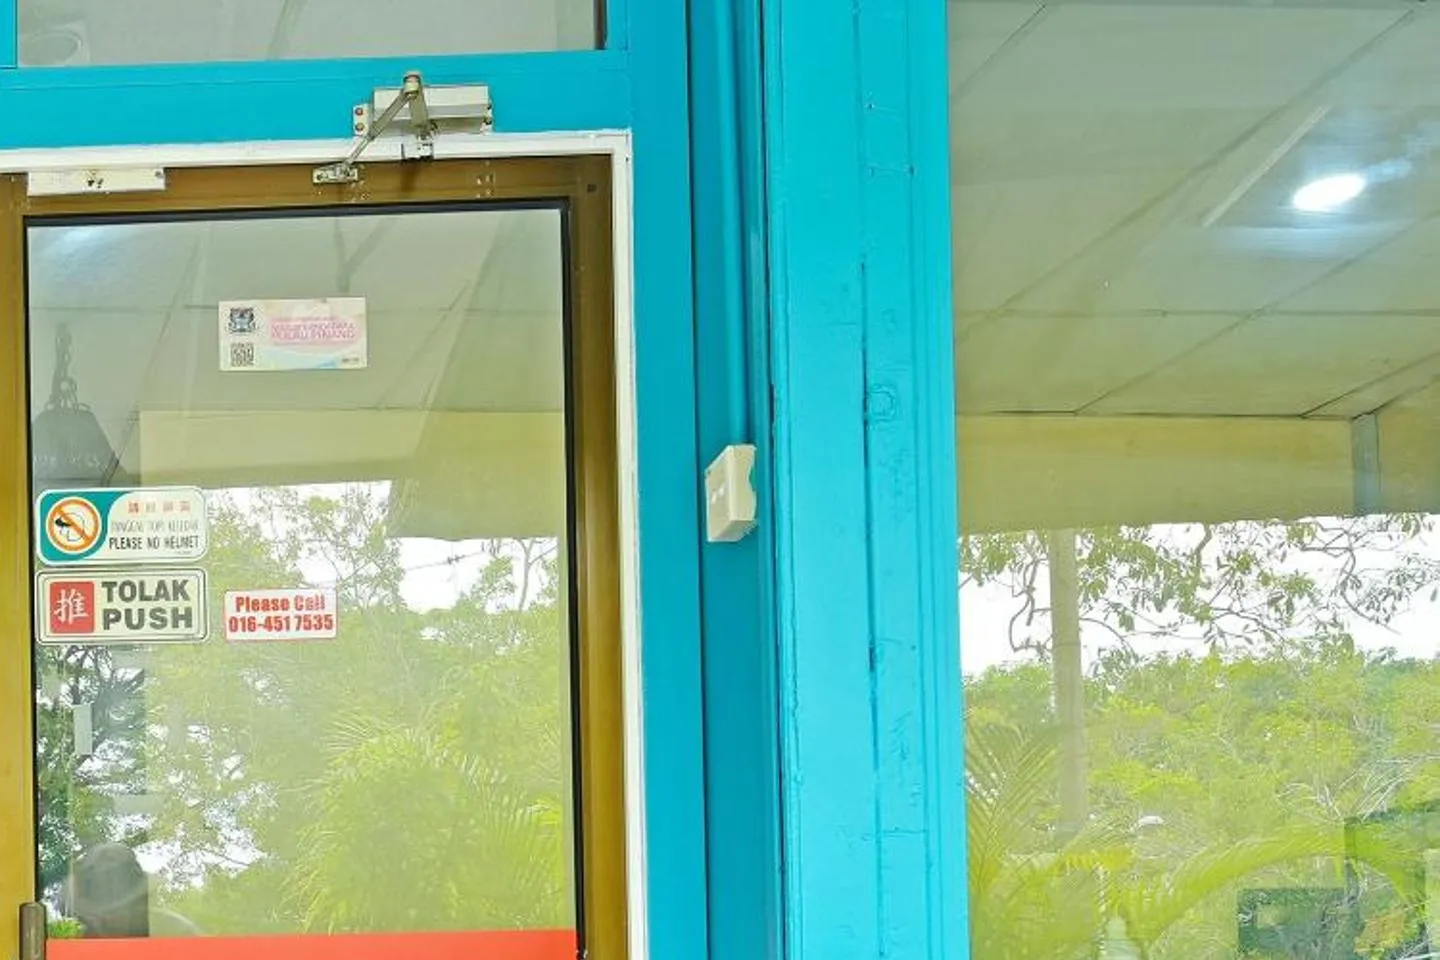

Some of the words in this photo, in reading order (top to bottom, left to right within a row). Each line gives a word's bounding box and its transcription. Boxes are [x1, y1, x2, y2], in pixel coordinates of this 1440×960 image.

[109, 536, 143, 550] PLEASE
[147, 535, 160, 550] NO
[164, 534, 199, 550] HELMET
[102, 579, 191, 603] TOLAK
[53, 587, 90, 625] 推
[235, 596, 290, 613] Please
[103, 607, 193, 631] PUSH
[228, 615, 291, 633] 016-451
[294, 613, 334, 632] 7535
